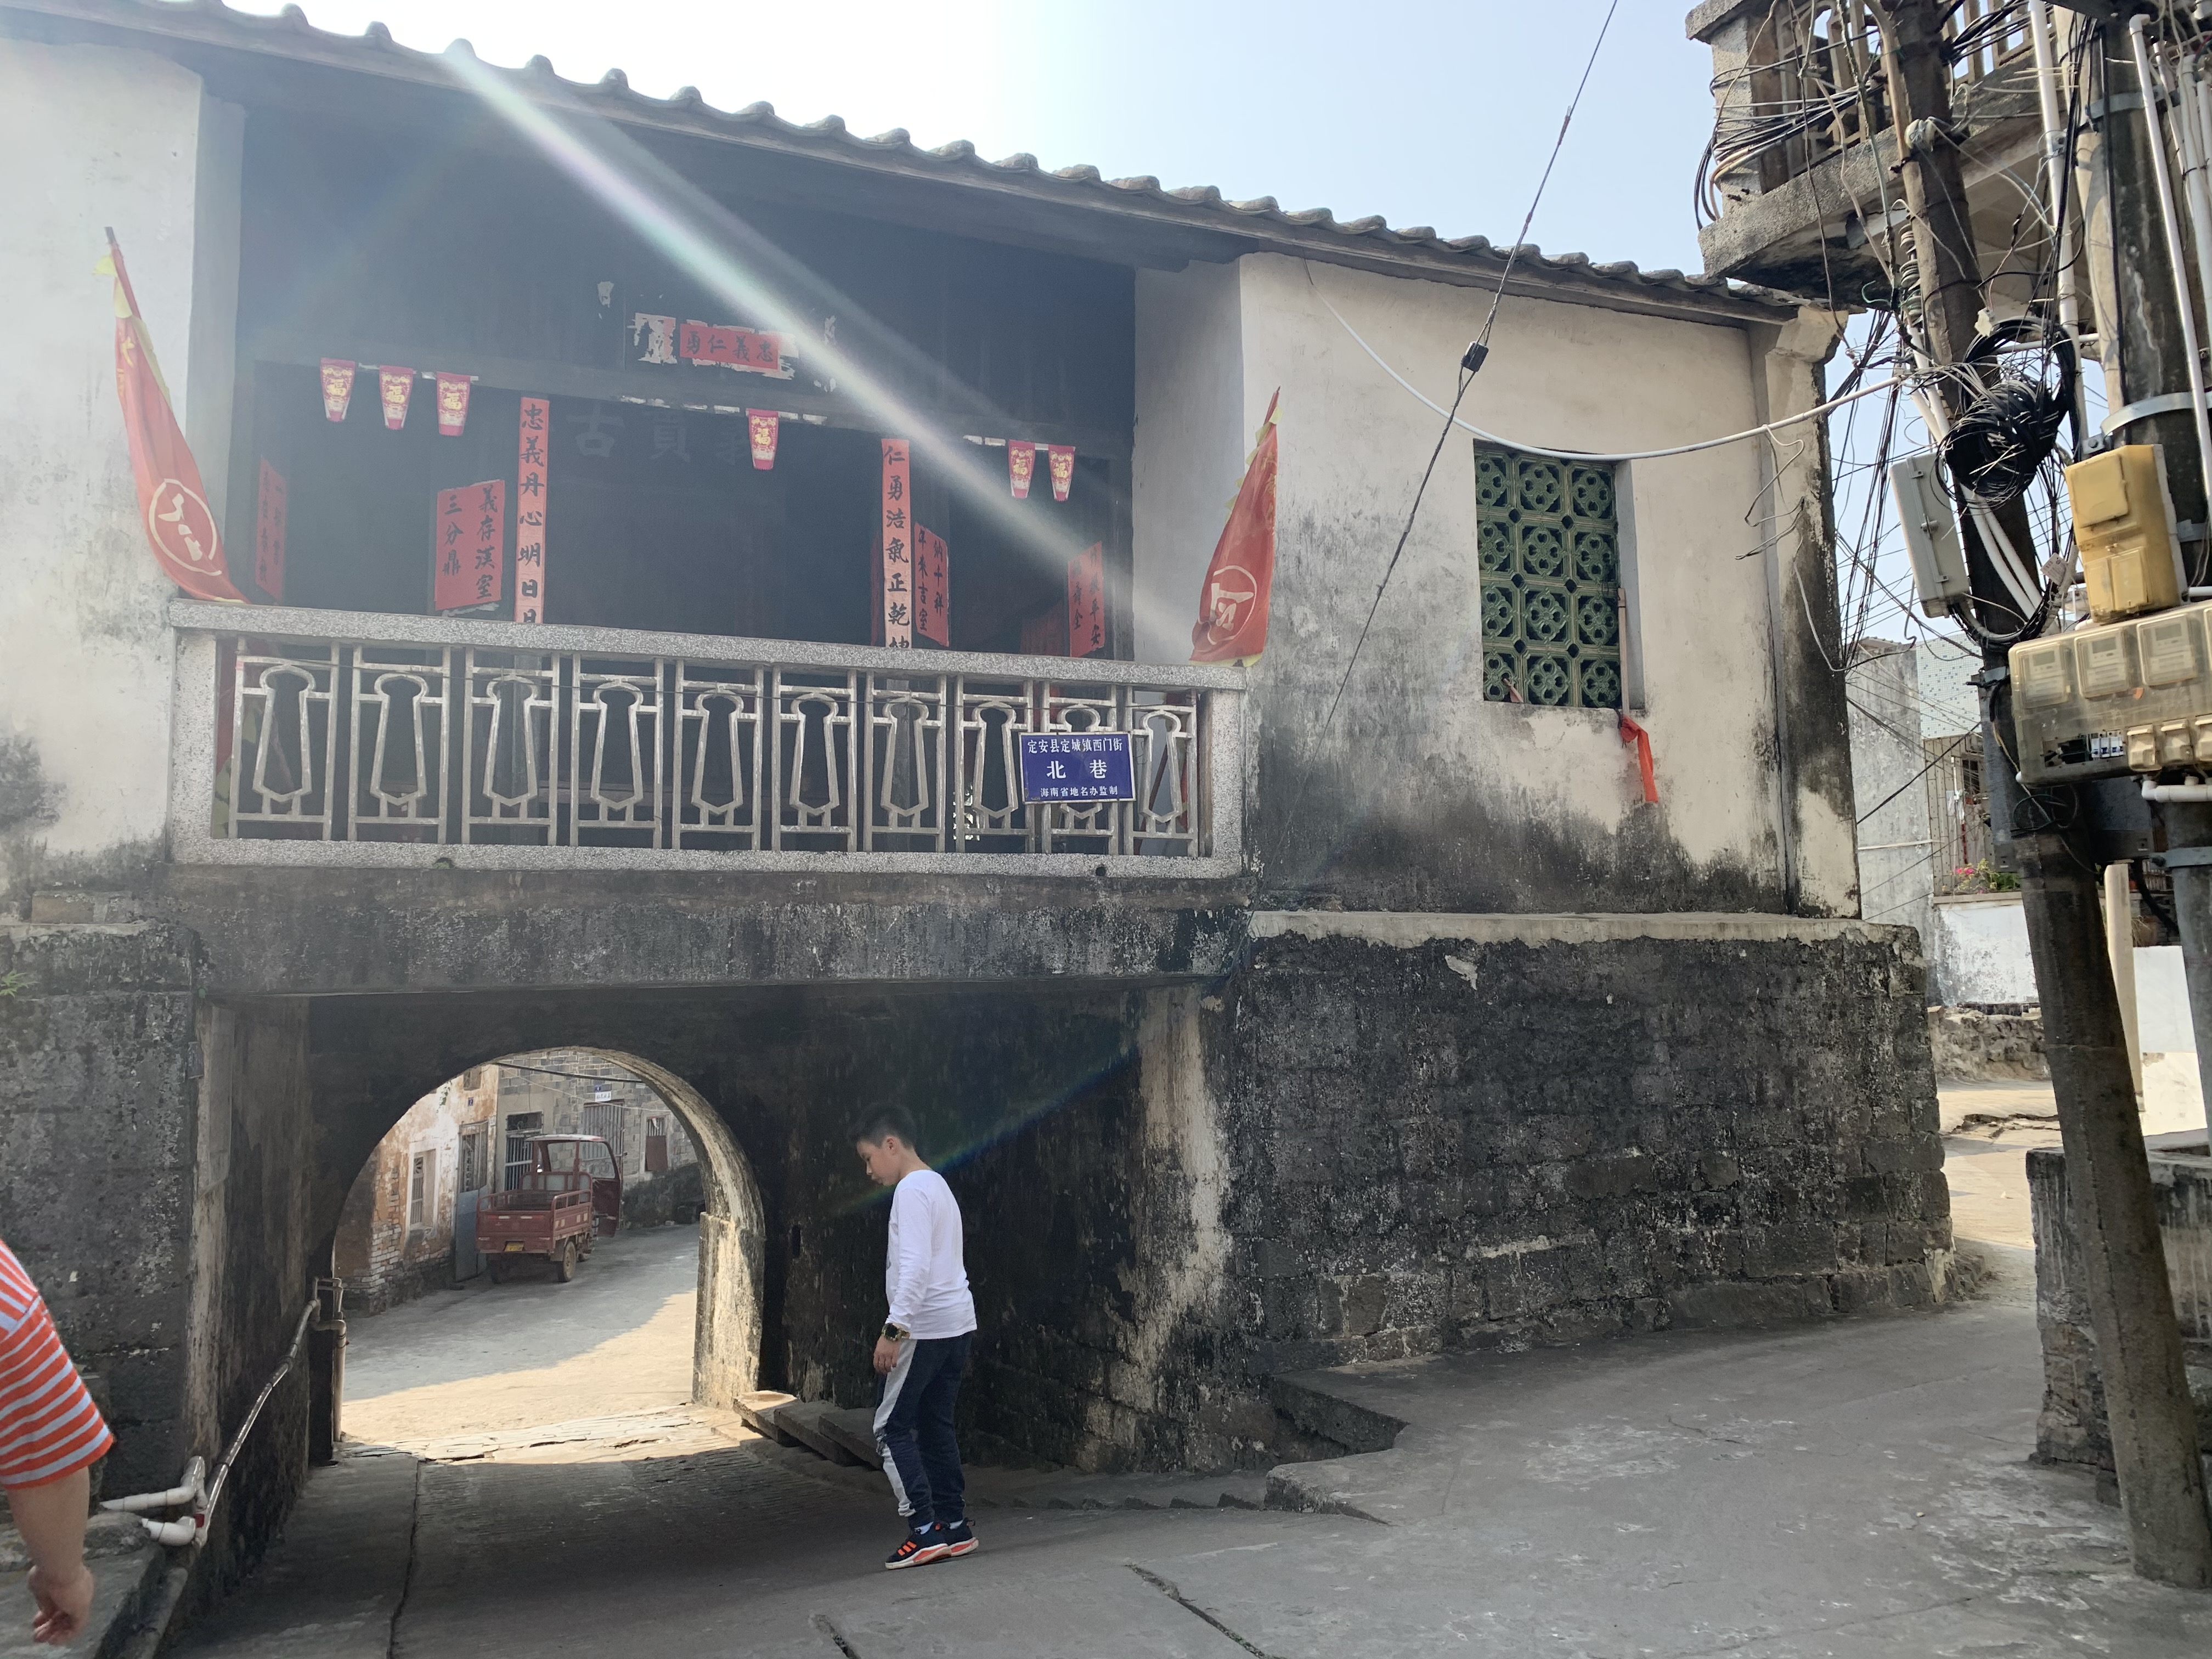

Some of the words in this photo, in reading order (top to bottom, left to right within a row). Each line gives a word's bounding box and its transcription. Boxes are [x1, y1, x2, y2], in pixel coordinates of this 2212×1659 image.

[442, 495, 464, 576] 三分鼎
[1028, 738, 1122, 754] 定安县定城镇西门街
[1046, 759, 1107, 779] 北巷
[1040, 786, 1119, 798] 海南省地名办监制
